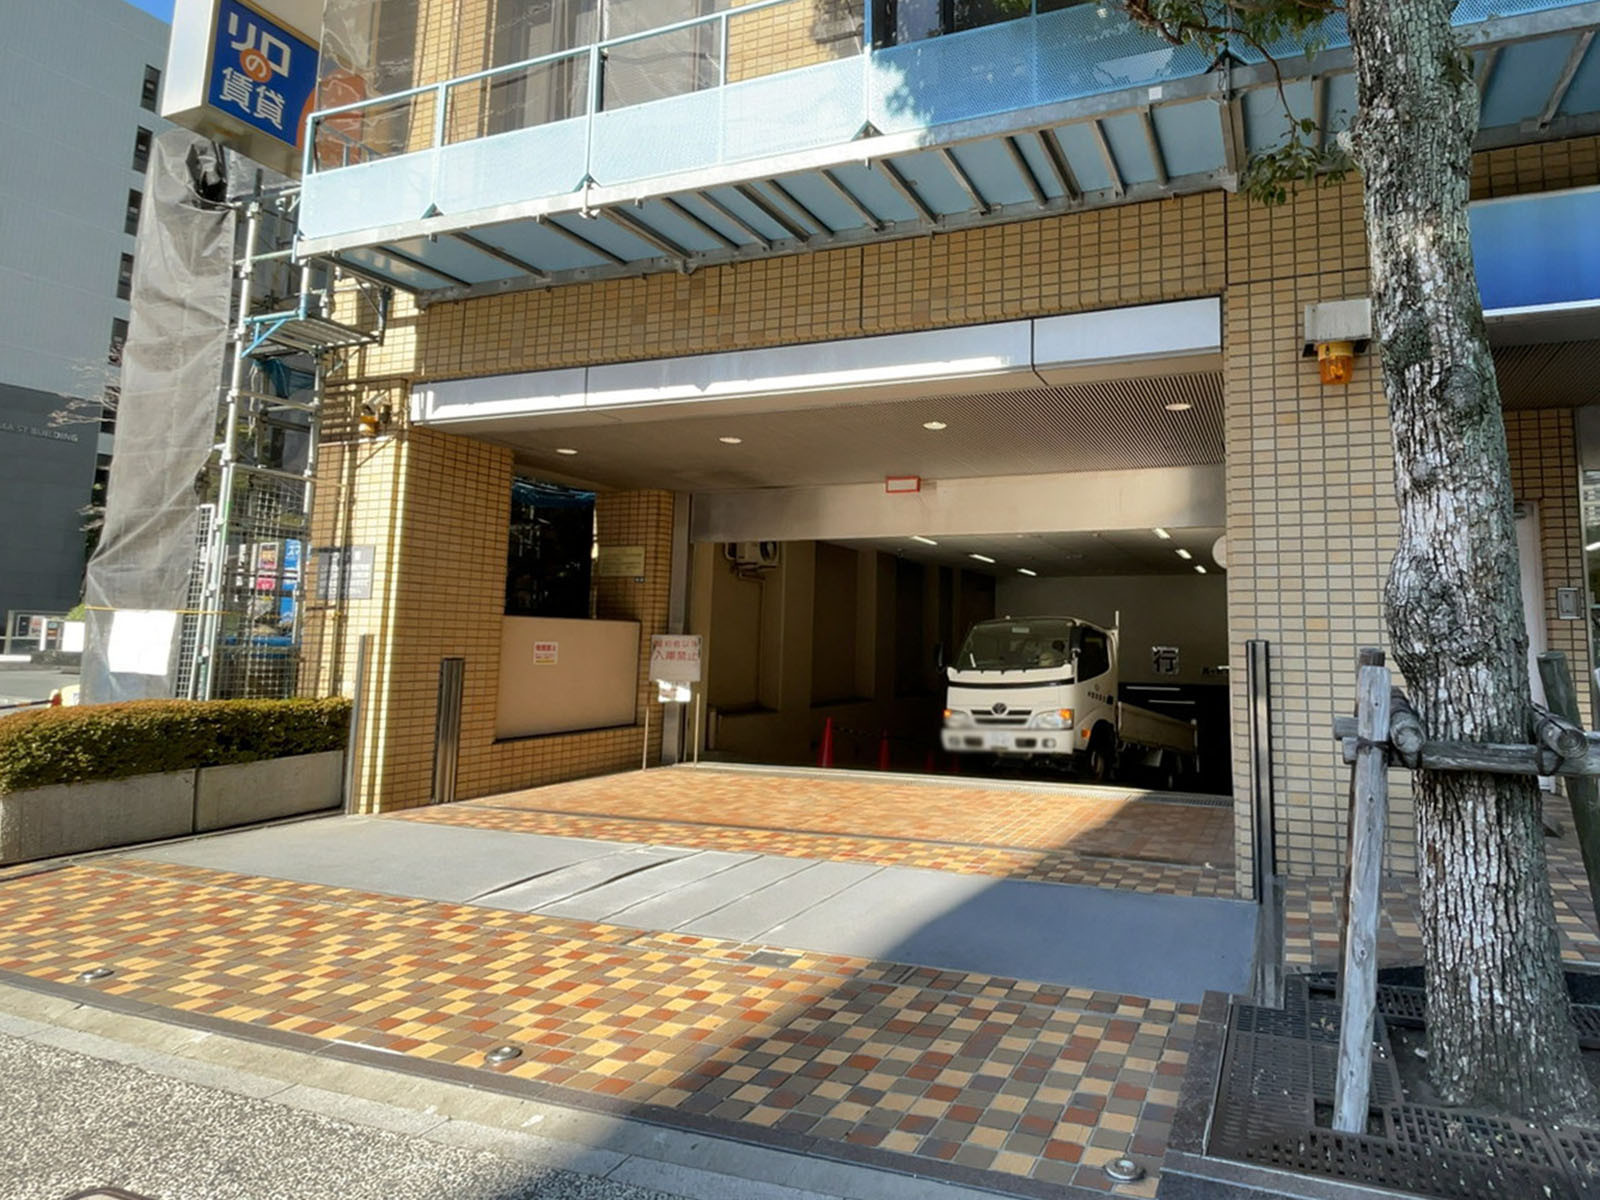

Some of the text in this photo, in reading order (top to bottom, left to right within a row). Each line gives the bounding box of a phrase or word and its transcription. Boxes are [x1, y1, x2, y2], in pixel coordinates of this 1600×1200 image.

[228, 11, 291, 78] リロ
[245, 54, 267, 78] の
[219, 66, 285, 130] 賃貸
